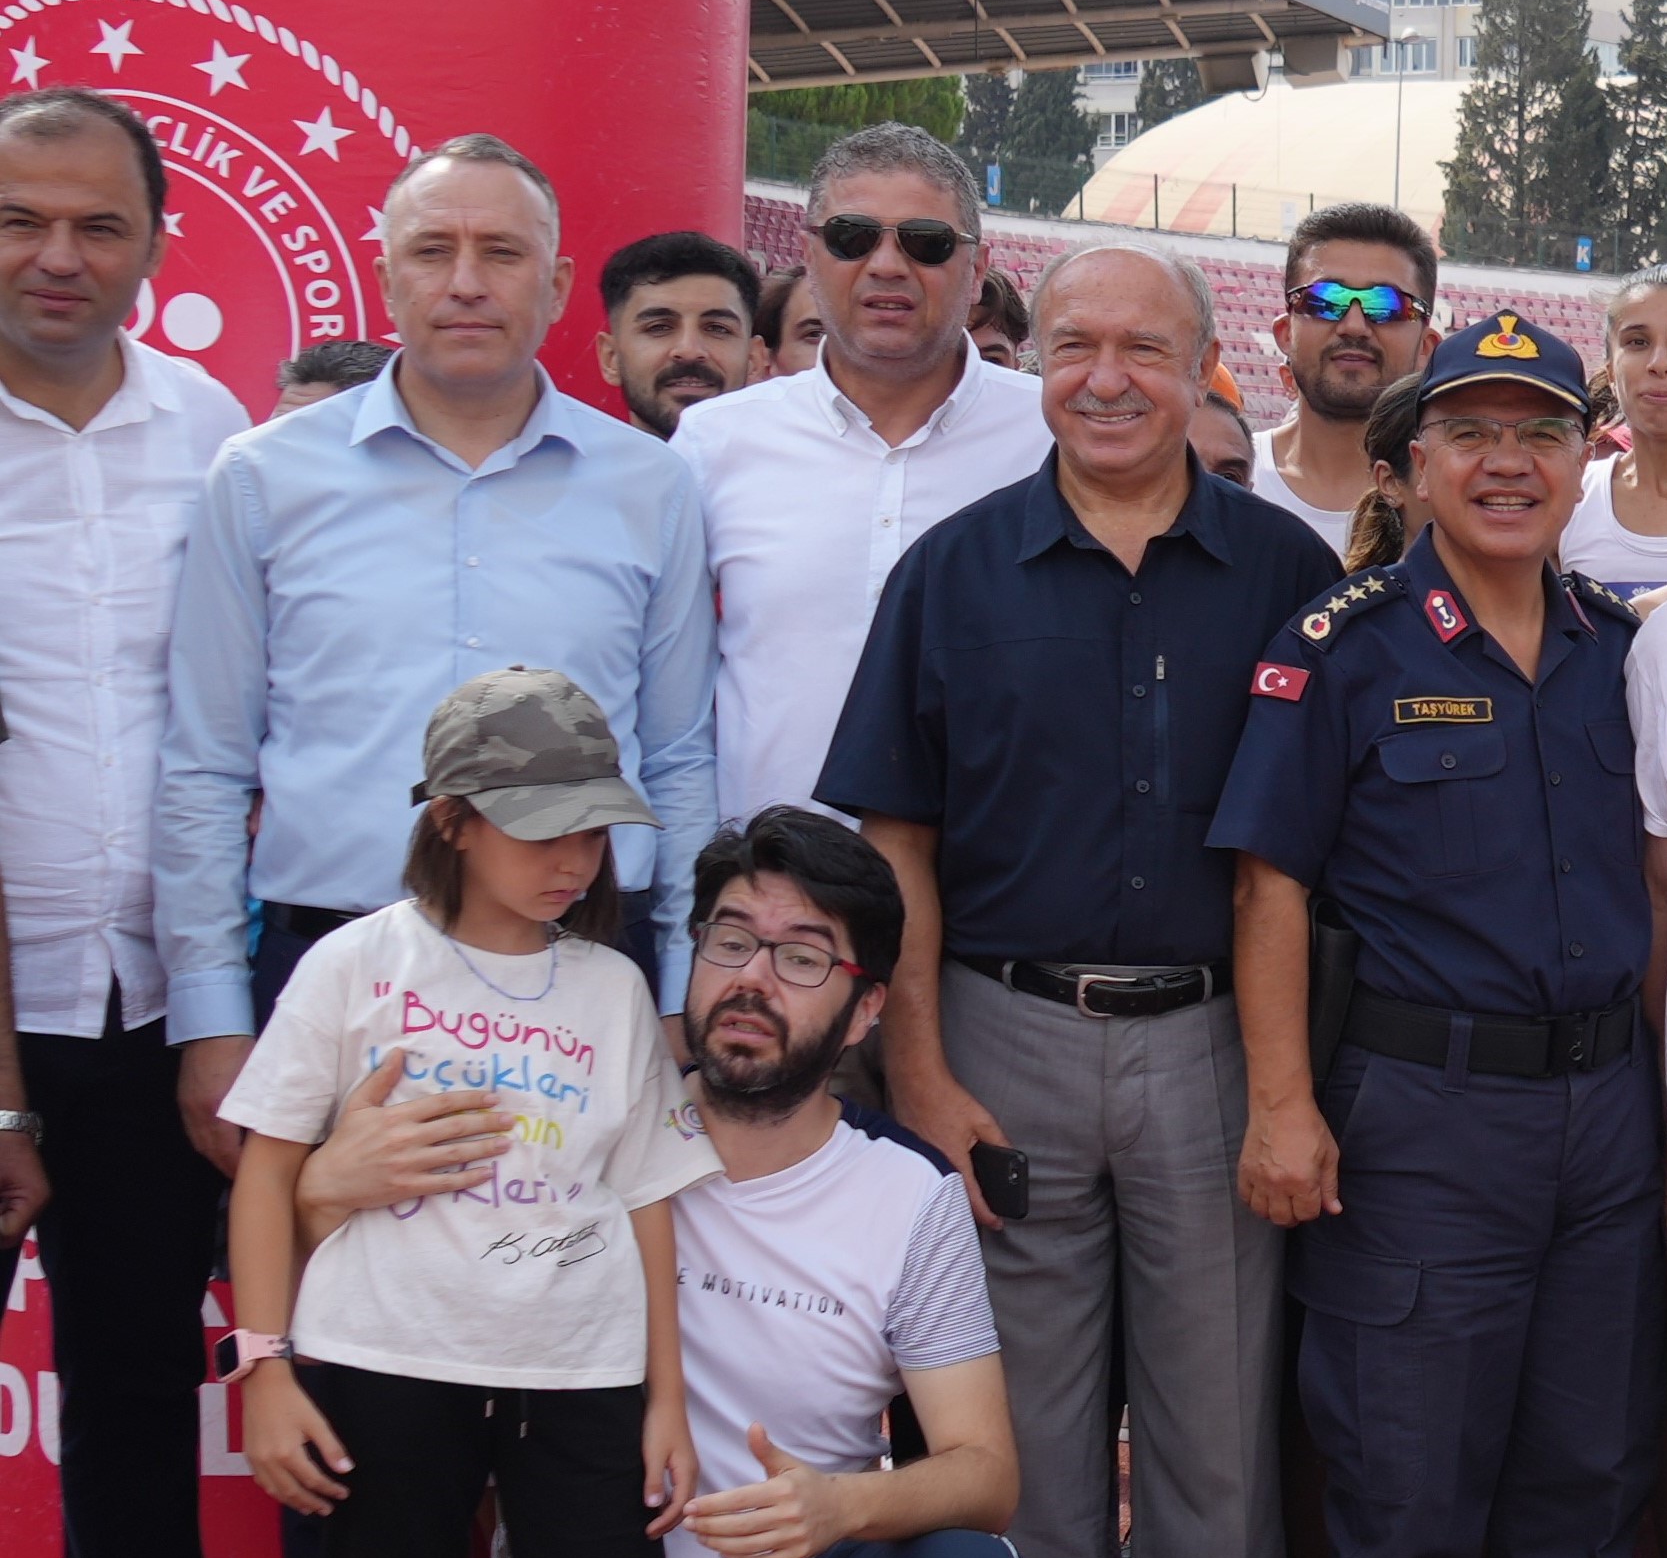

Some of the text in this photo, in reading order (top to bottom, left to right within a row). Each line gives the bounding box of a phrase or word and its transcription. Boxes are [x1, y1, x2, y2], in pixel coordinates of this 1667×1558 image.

[242, 165, 299, 224] VE
[281, 225, 346, 339] SPOR
[1576, 245, 1590, 263] K
[1412, 702, 1477, 717] TAŞYÜREK
[701, 1272, 846, 1317] MOTIVATION
